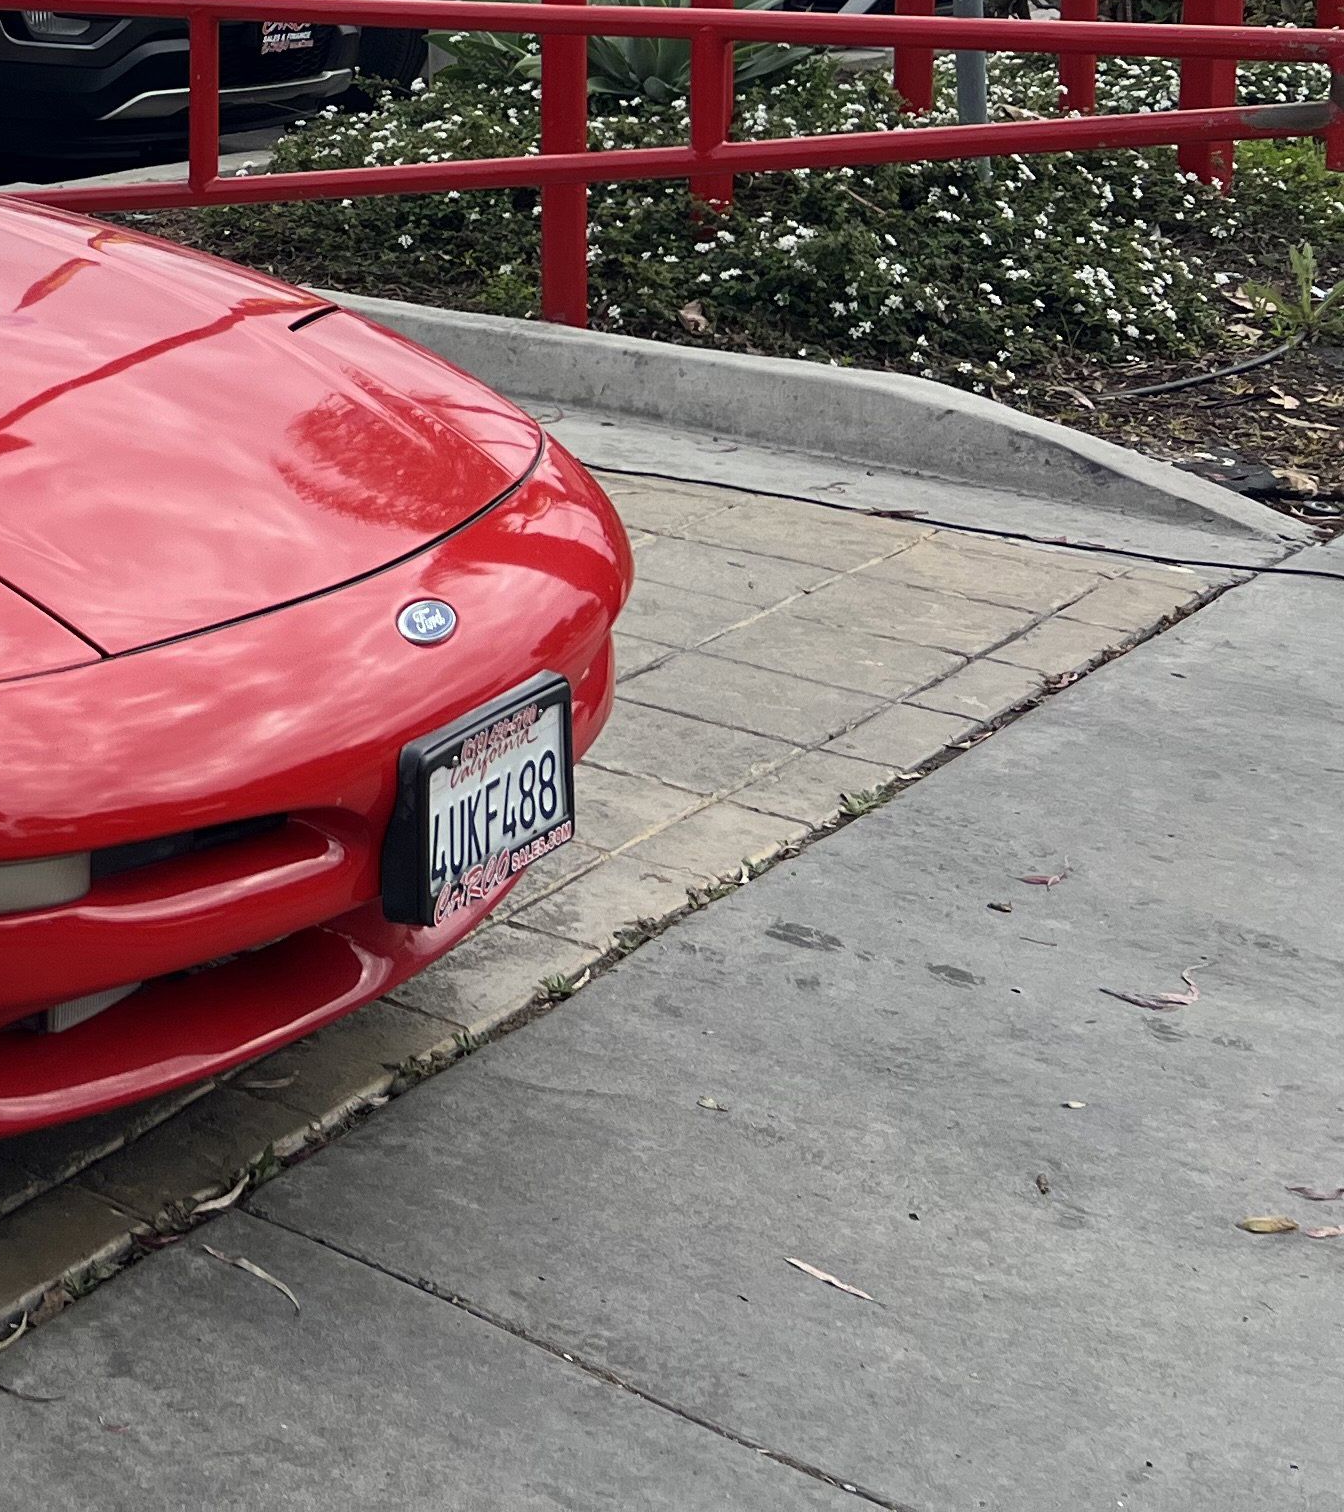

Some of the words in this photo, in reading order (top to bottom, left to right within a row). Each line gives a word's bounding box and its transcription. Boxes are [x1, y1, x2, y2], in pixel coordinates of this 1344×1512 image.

[412, 607, 446, 634] Ford
[450, 729, 539, 789] California
[431, 749, 557, 882] 4UKF488
[434, 847, 511, 927] CARCO
